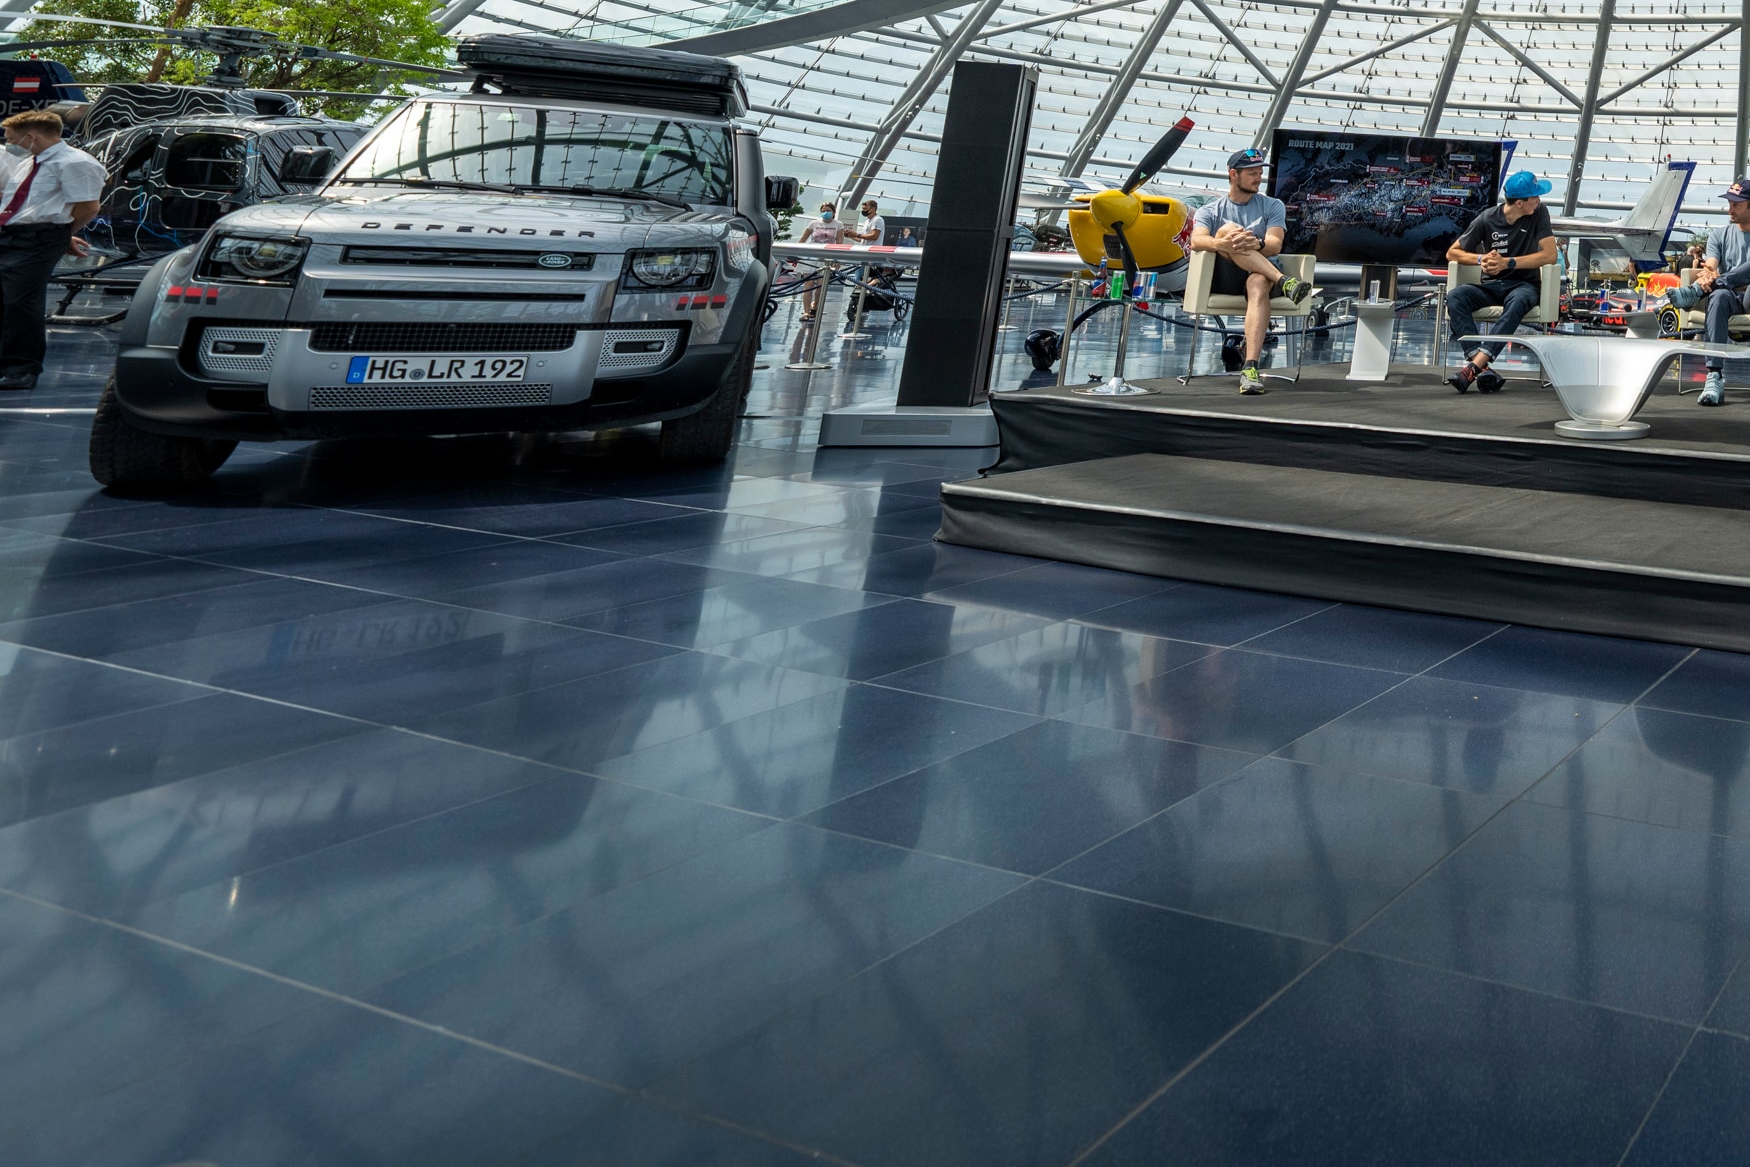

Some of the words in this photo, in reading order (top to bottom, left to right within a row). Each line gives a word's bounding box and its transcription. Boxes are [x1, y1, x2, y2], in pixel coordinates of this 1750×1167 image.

[1288, 139, 1315, 148] ROUTE
[1315, 140, 1334, 150] MAP
[1335, 142, 1354, 151] 2021
[361, 221, 596, 238] DEFENDER
[367, 359, 409, 380] HG
[426, 359, 466, 379] LR
[470, 359, 525, 379] 192
